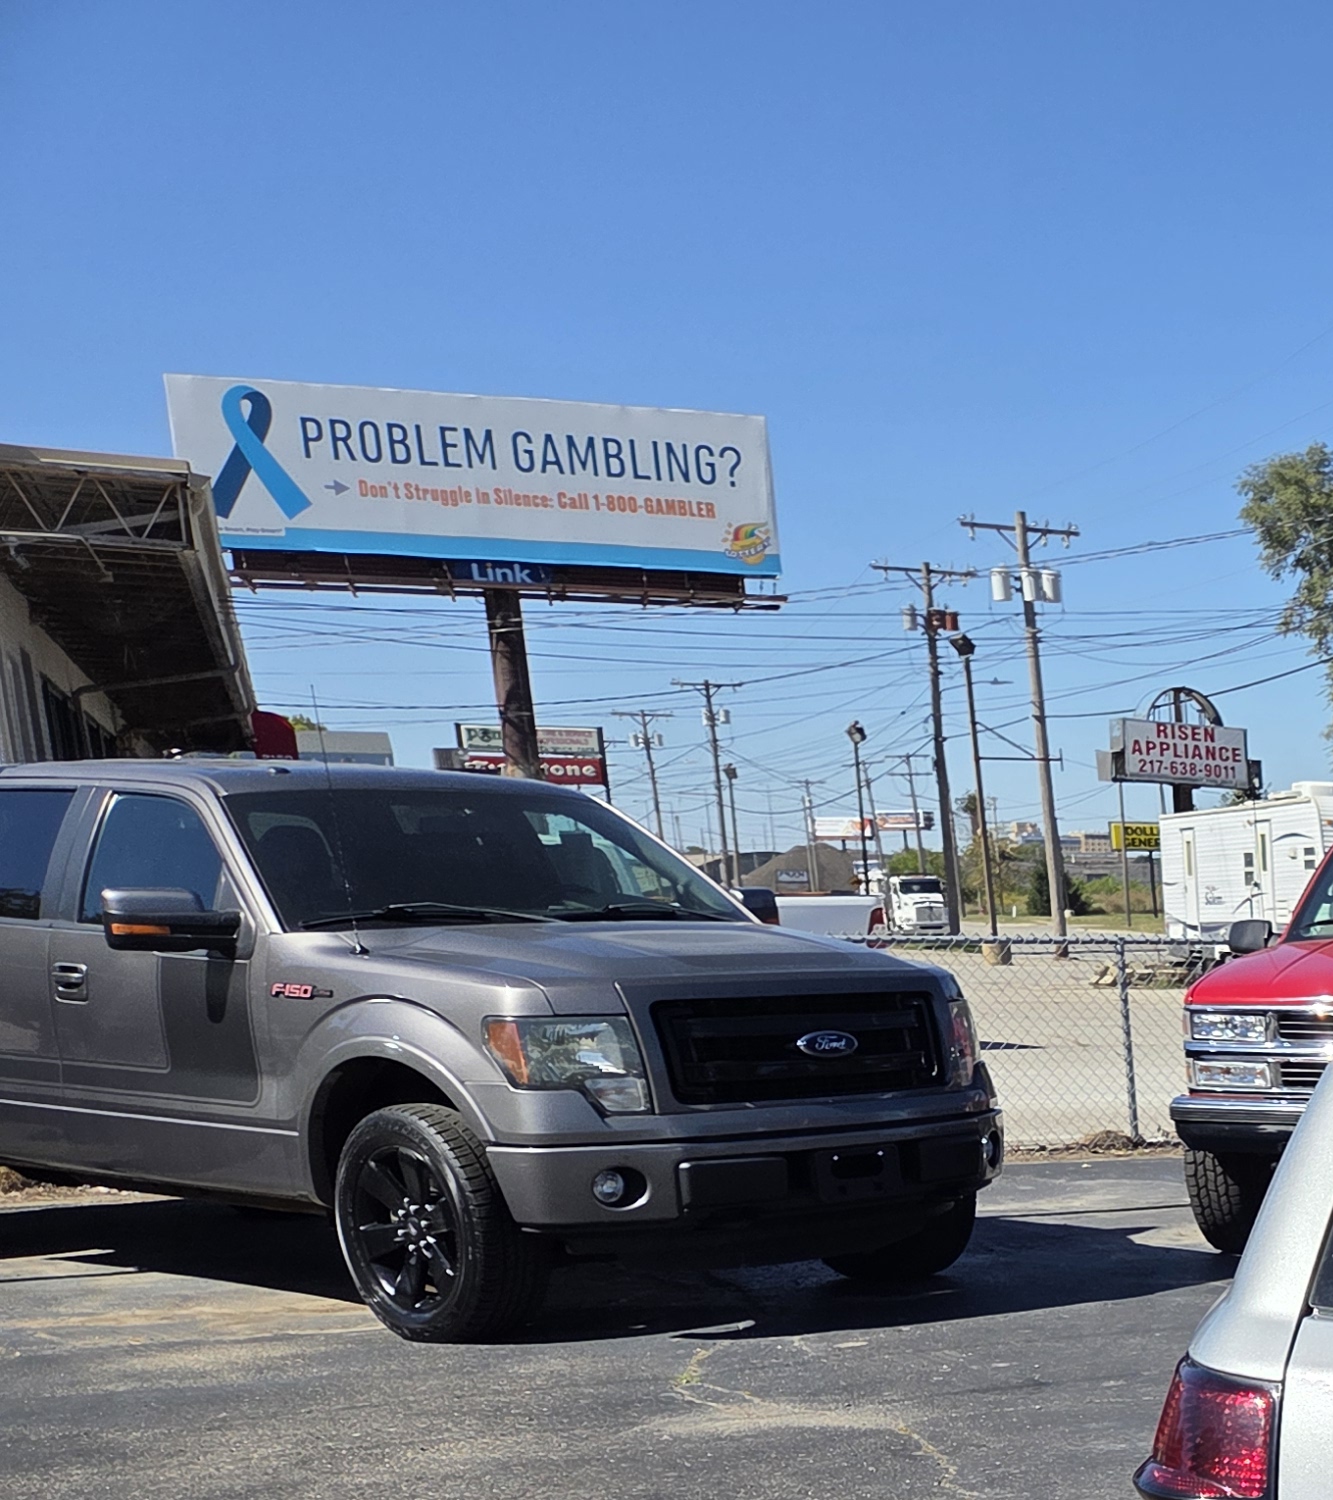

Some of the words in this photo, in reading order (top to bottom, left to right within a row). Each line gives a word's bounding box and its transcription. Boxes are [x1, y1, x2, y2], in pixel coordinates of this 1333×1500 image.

[299, 416, 498, 470] PROBLEM
[511, 431, 743, 488] GAMBLING?
[358, 478, 401, 499] Don't
[404, 482, 473, 507] Struggle
[494, 487, 555, 509] Silence:
[557, 491, 590, 510] Call
[594, 493, 716, 519] 1-800-GAMBLER
[724, 536, 772, 560] LOTTERY
[470, 562, 534, 584] Link
[1156, 723, 1216, 743] RISEN
[1131, 739, 1242, 763] APPLIANCE
[1138, 758, 1237, 779] 217-638-9011
[1125, 826, 1159, 837] DOLL
